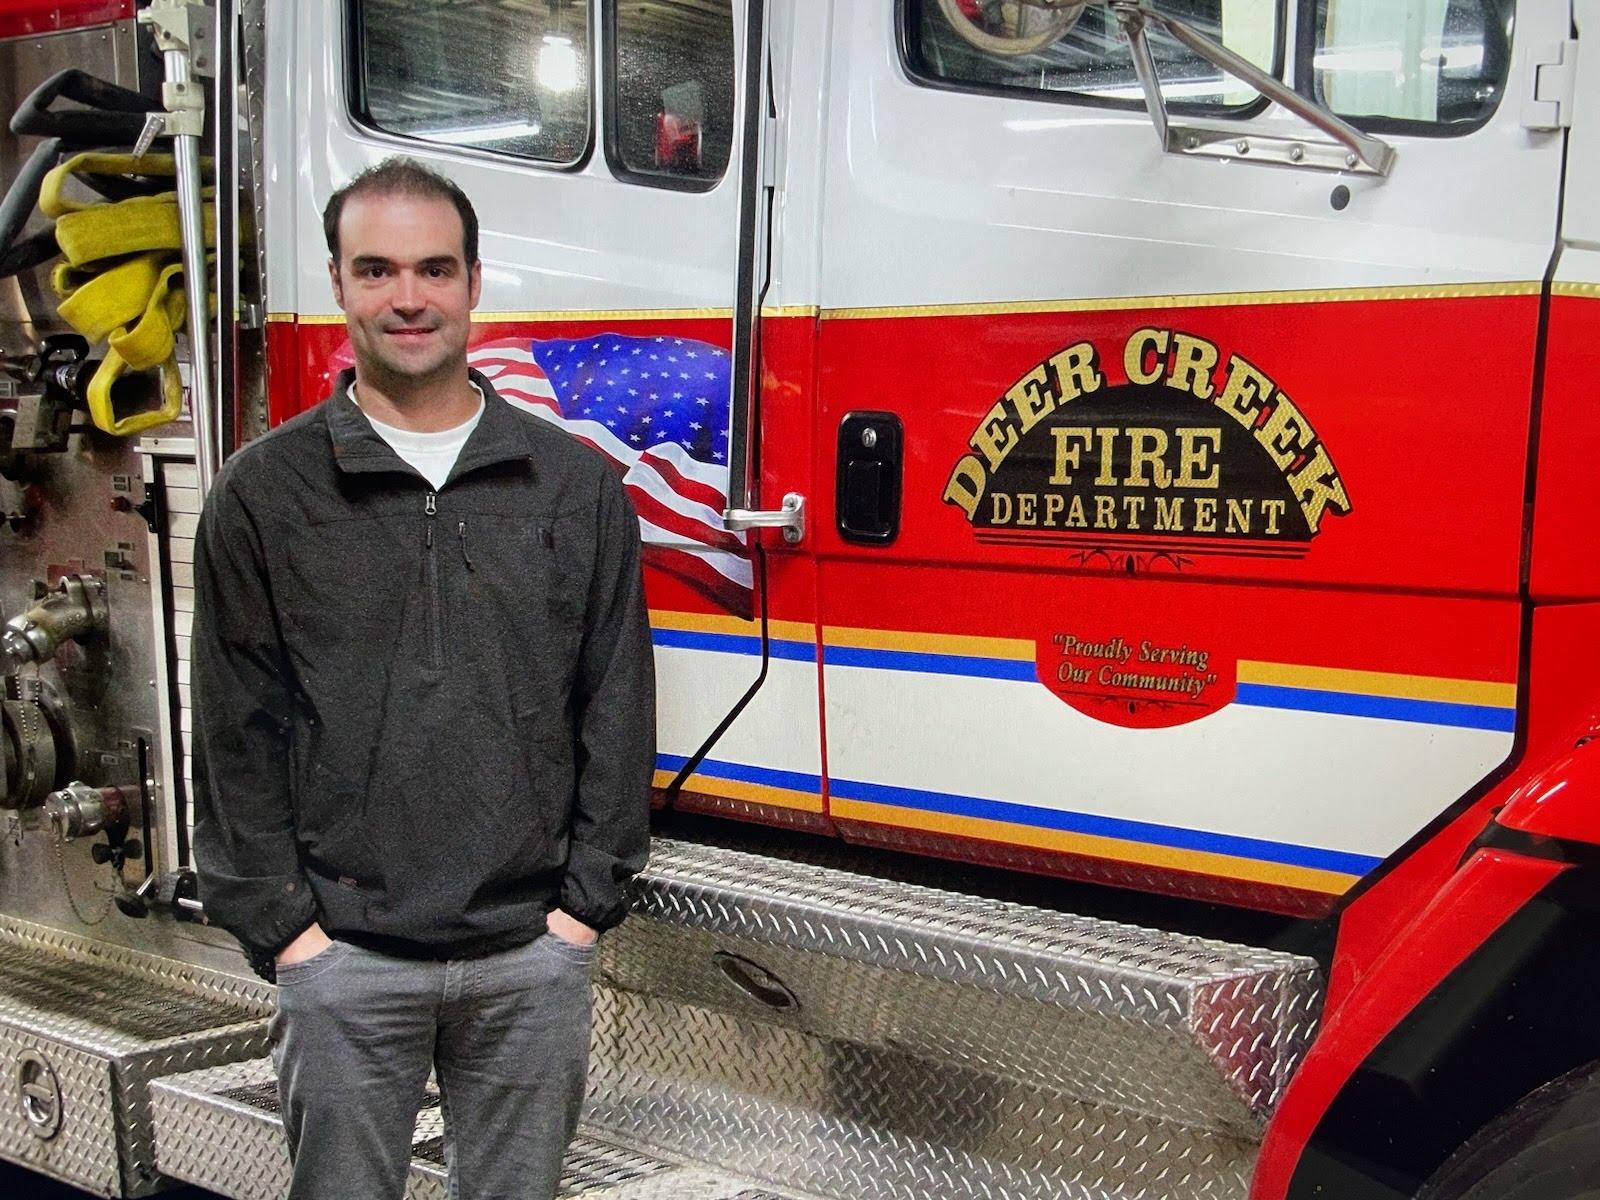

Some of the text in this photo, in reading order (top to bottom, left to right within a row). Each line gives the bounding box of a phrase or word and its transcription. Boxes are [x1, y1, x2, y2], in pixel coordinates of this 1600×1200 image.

[945, 328, 1350, 534] DEER CREEK
[1048, 427, 1222, 489] FIRE
[990, 492, 1286, 535] DEPARTMENT
[1058, 662, 1092, 683] Our
[1138, 641, 1209, 671] Serving
